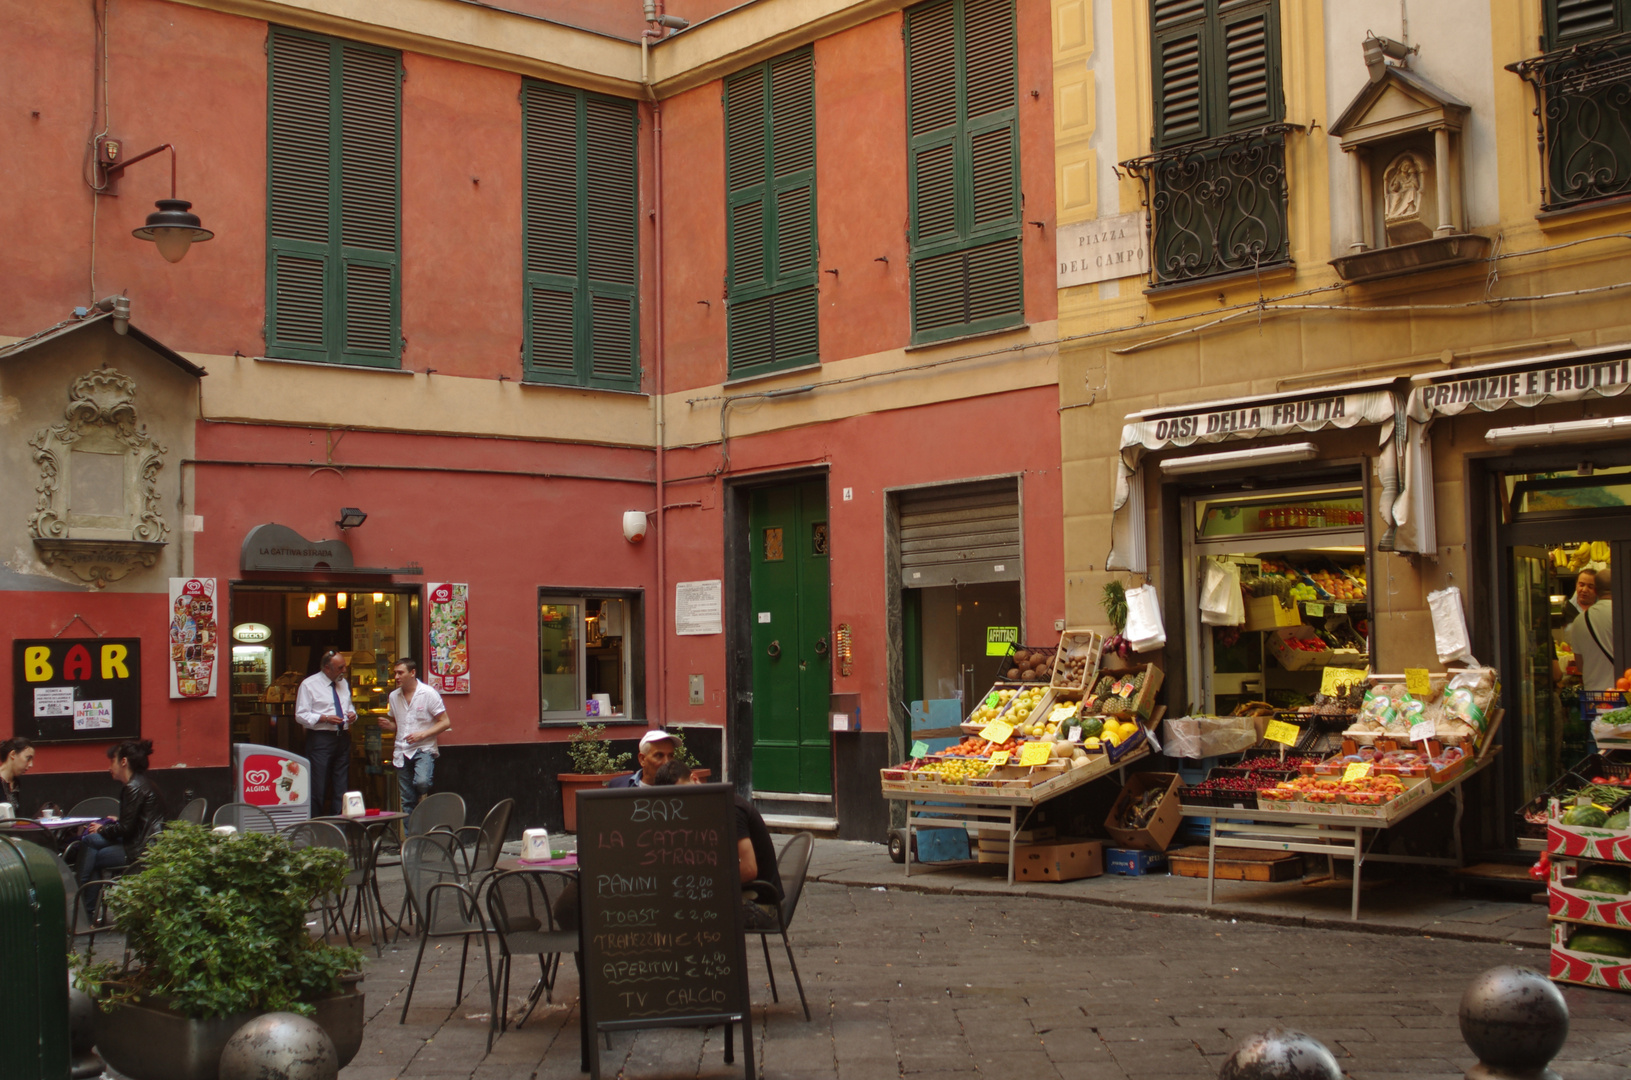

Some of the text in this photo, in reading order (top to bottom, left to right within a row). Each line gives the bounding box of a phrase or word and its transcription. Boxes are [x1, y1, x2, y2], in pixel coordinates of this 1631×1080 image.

[1079, 228, 1125, 247] PIAZZA
[1060, 247, 1144, 275] DEL CAMPO
[1422, 359, 1629, 410] PRIMIZIE E FRUTTI
[1155, 396, 1346, 441] OASI DELLA FRUTTA
[259, 547, 333, 557] LA CATTIVA STRADA
[988, 629, 1016, 643] AFFITTASI
[24, 643, 130, 682] BAR
[82, 702, 104, 710] SALA
[245, 785, 270, 793] ALGIDA
[630, 798, 689, 822] BAR
[598, 829, 719, 849] LA CATTIVA
[640, 848, 718, 867] STRADA
[596, 873, 657, 894] PANINI
[600, 908, 660, 923] TOAST
[593, 931, 672, 949] TRAMEZZINI
[602, 960, 679, 979] APERITIVI
[618, 986, 726, 1008] TV CALCIO
